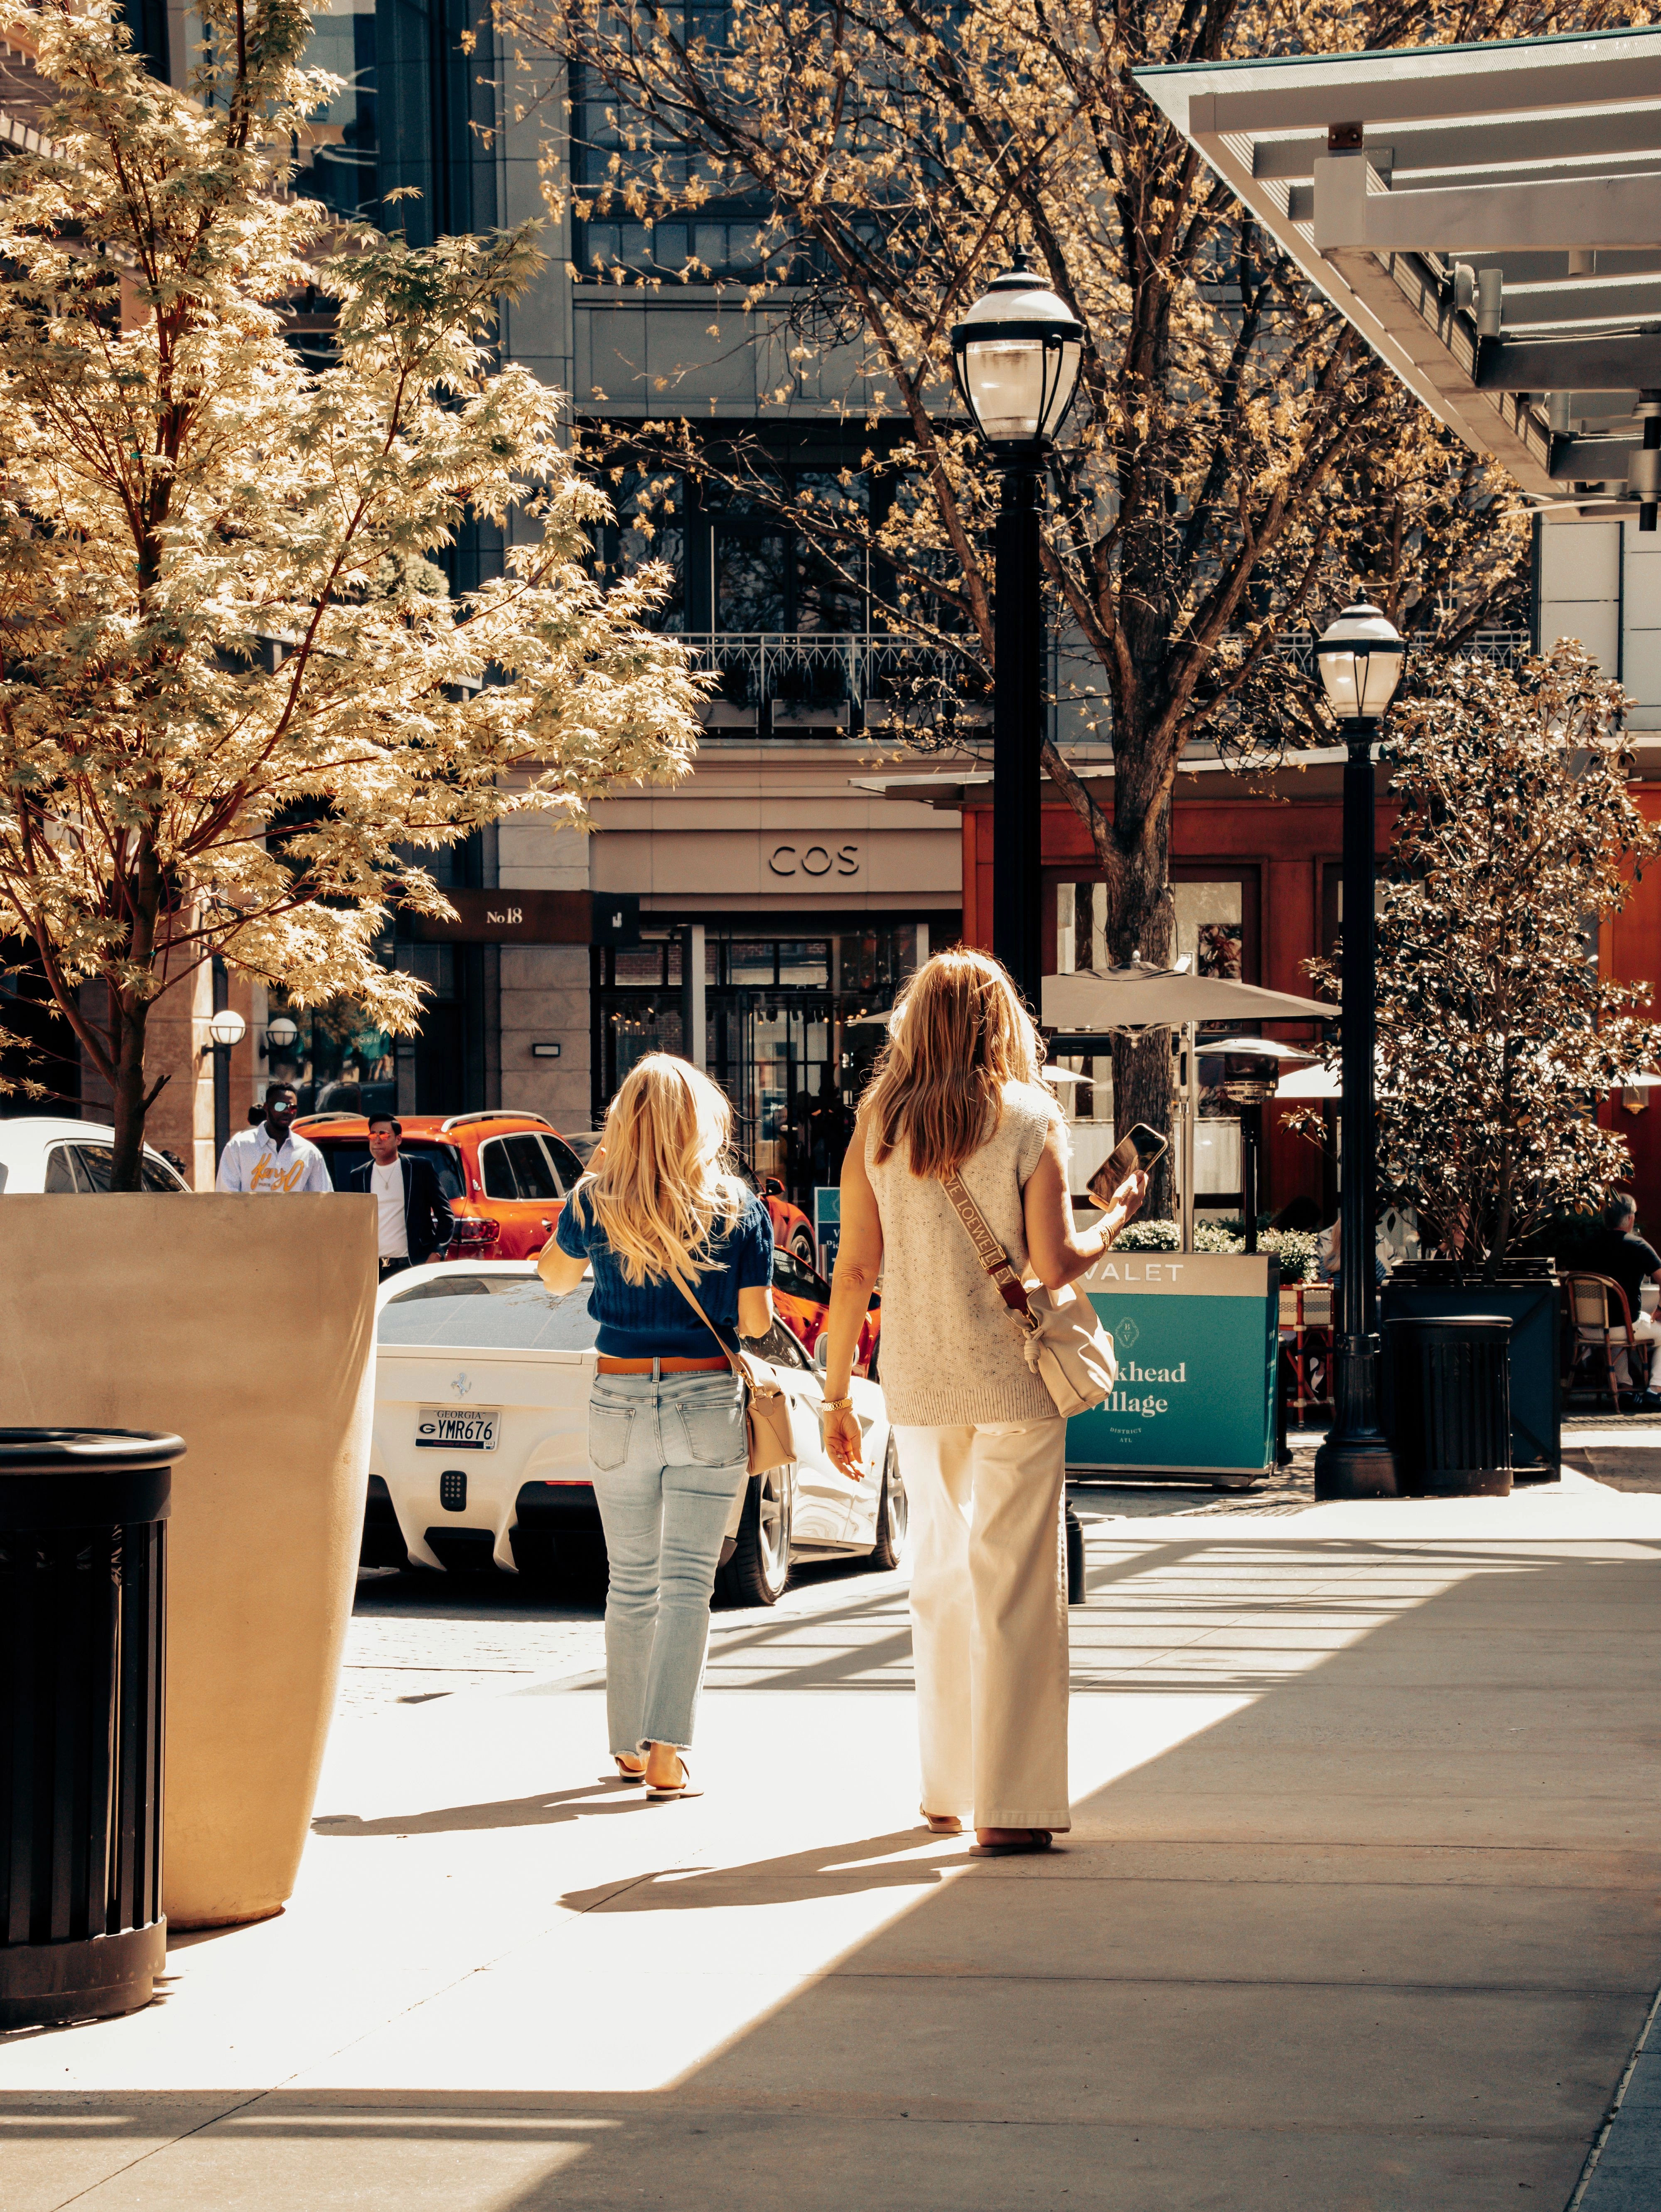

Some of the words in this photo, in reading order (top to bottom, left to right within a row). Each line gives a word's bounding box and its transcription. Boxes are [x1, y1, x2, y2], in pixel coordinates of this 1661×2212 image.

[769, 846, 859, 876] COS
[956, 1198, 993, 1251] LOEWE
[1084, 1262, 1184, 1282] VALET
[1114, 1361, 1187, 1382] khead
[437, 1410, 482, 1419] GEORGIA
[1092, 1391, 1168, 1417] illage
[438, 1419, 493, 1440] YMR676
